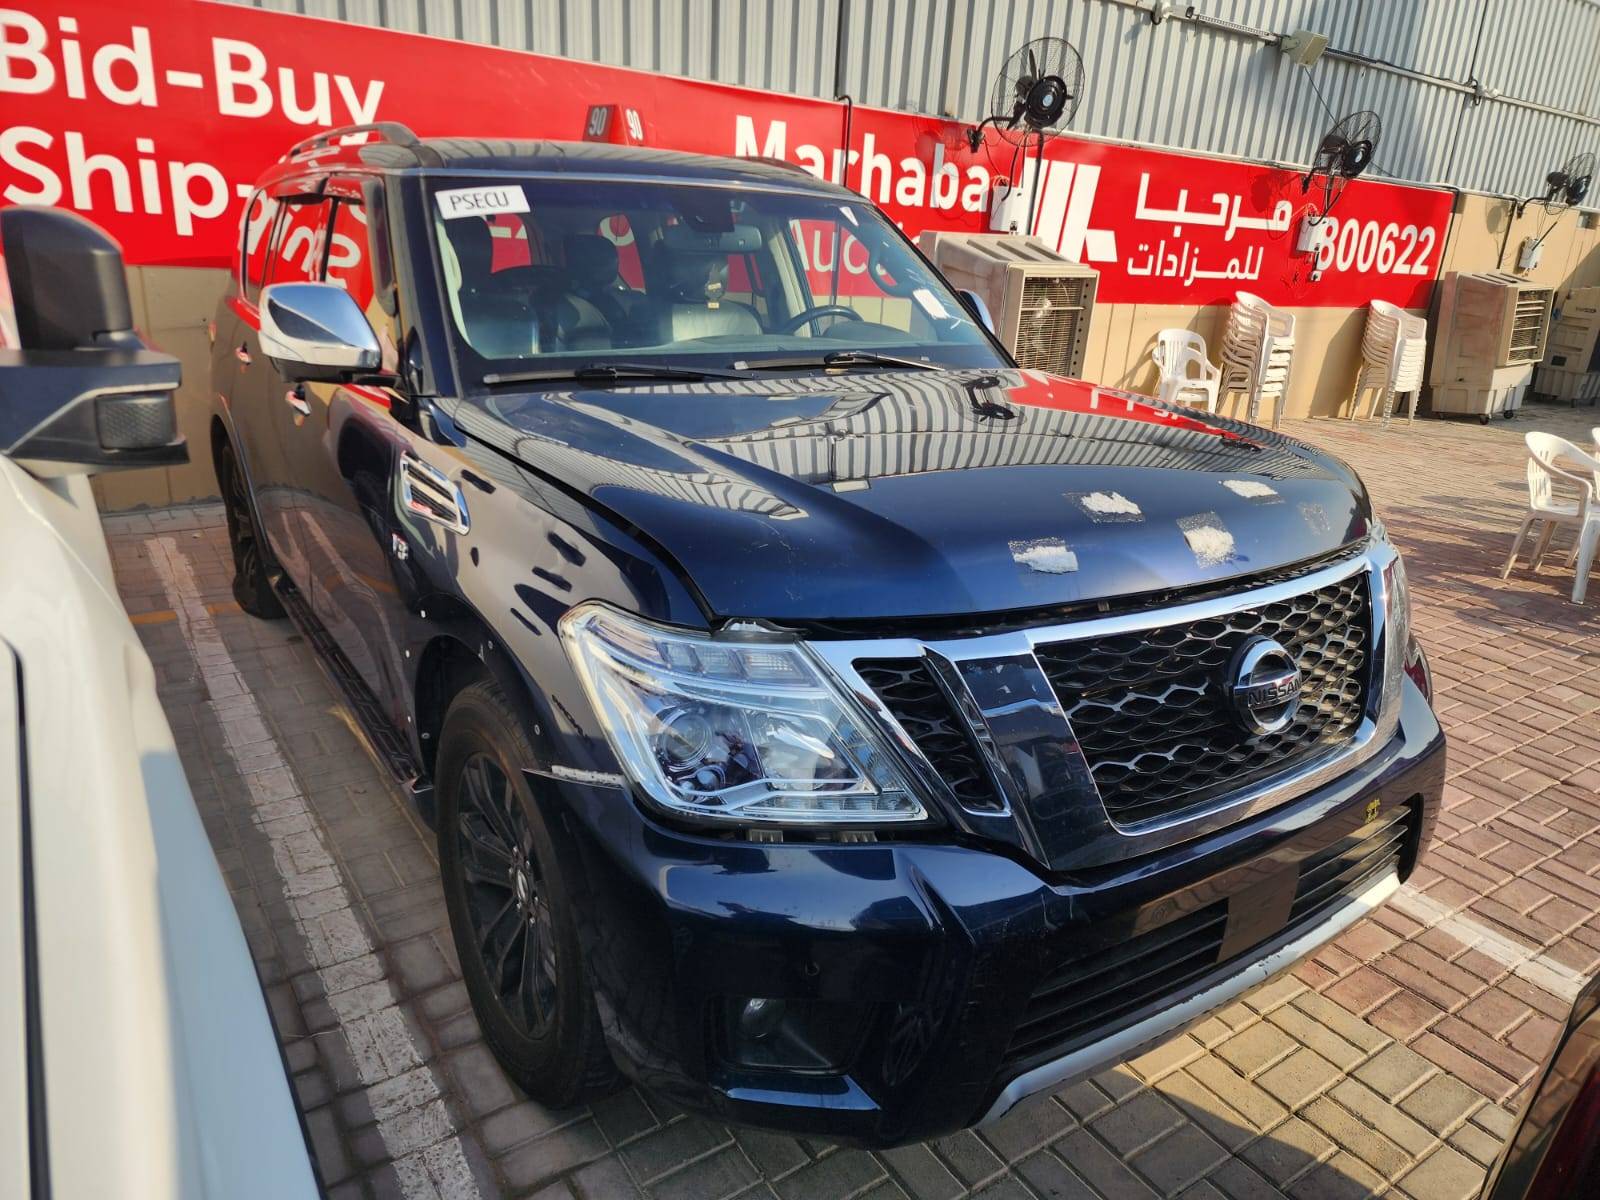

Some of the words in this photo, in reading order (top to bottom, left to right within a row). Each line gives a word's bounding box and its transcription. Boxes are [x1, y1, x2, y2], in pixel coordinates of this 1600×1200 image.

[0, 8, 385, 146] Bid-Buy
[588, 107, 608, 136] 90
[626, 108, 644, 141] 90
[735, 114, 991, 212] Marhaba
[449, 191, 509, 211] PSECU
[1135, 172, 1293, 241] مرحبا
[1127, 240, 1264, 286] للمزادات
[1248, 678, 1301, 705] NISSAN
